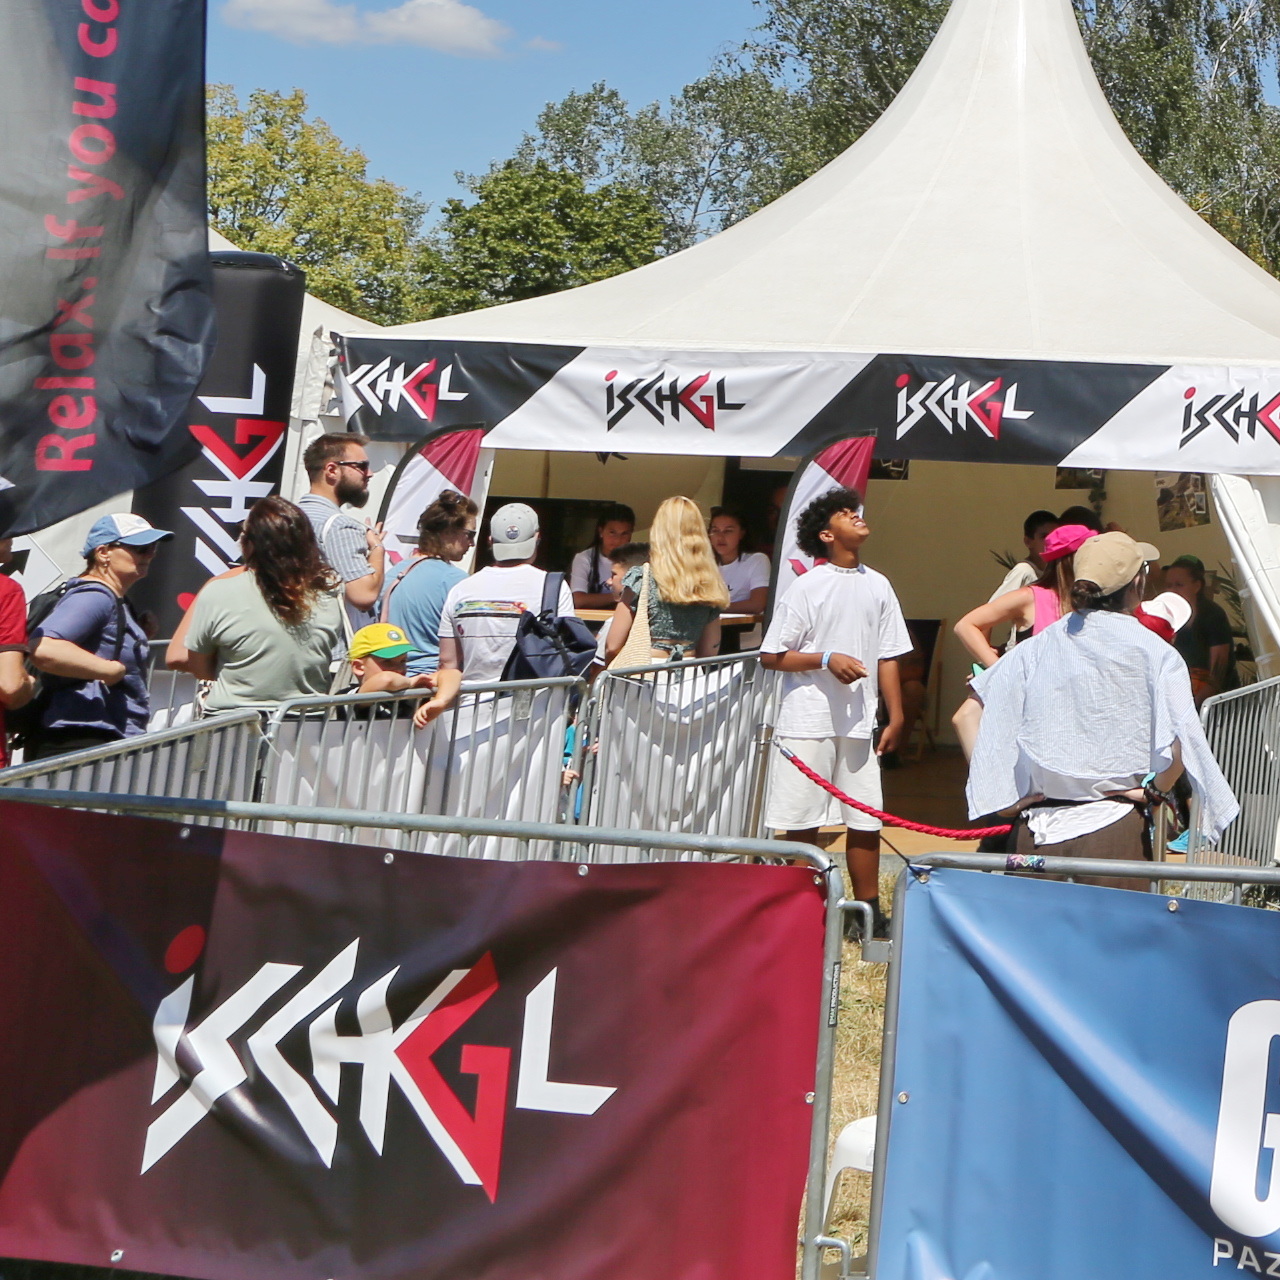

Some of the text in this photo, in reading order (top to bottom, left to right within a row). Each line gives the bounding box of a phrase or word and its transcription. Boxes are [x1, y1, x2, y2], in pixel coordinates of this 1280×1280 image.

[66, 76, 126, 205] you
[44, 214, 105, 261] If
[34, 275, 98, 472] Relax.
